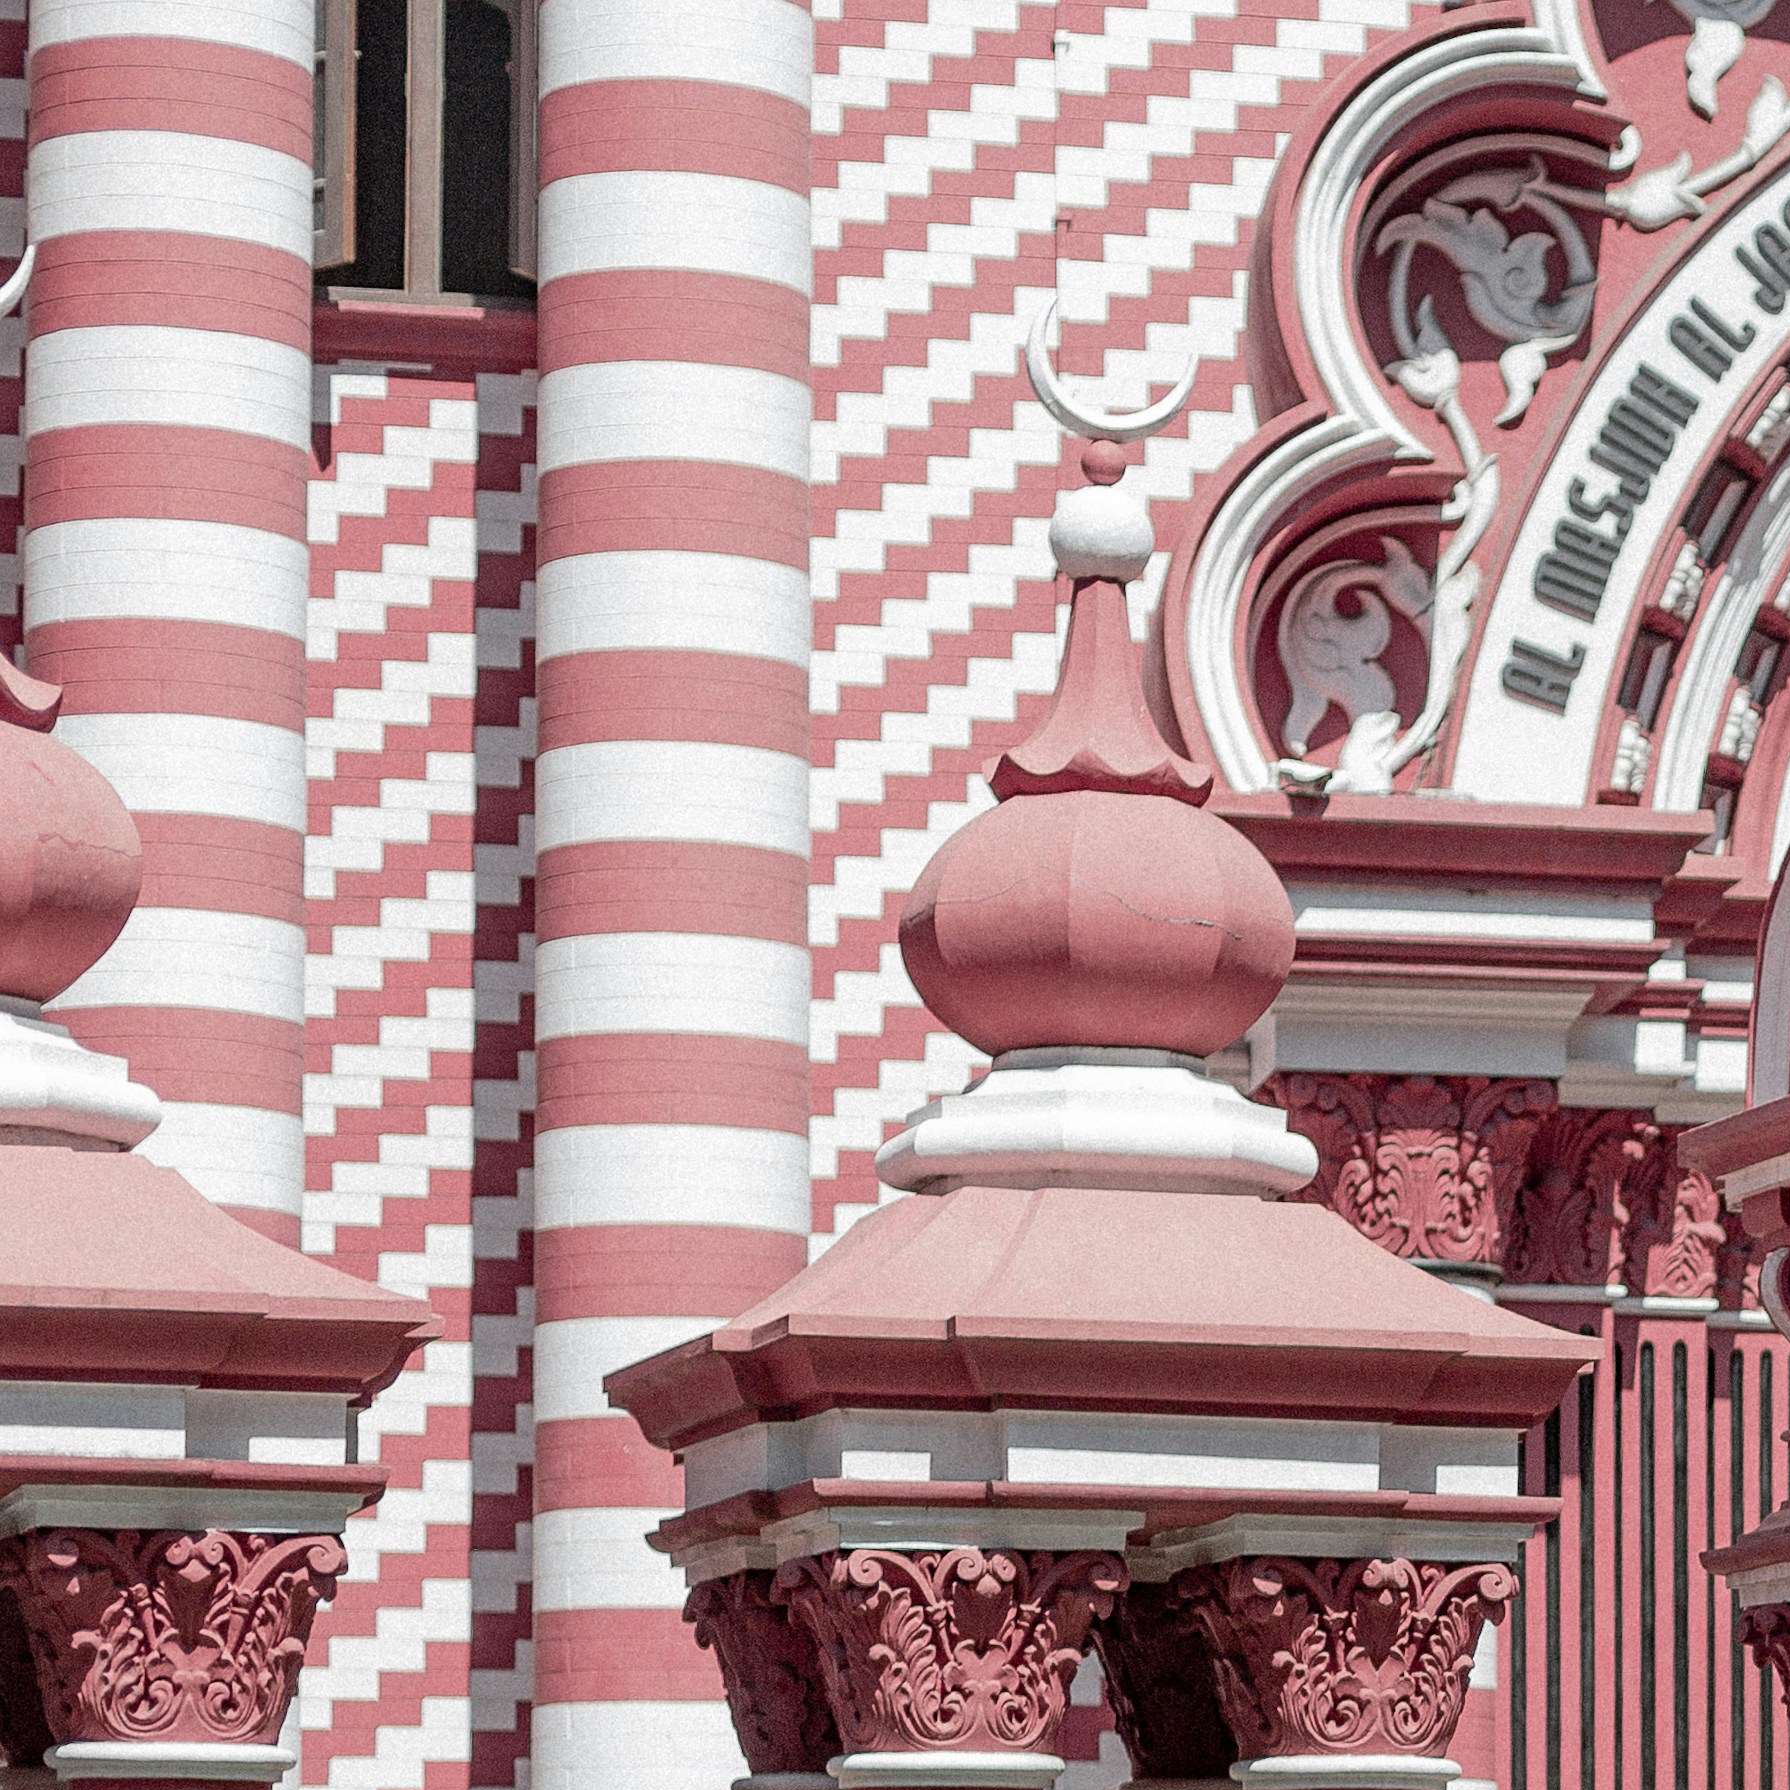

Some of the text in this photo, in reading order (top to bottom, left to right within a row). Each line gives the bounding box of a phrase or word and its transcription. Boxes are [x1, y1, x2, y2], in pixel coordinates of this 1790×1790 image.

[1669, 295, 1757, 383] AL
[1535, 360, 1700, 624] MASJIDH
[1502, 637, 1587, 716] AL
